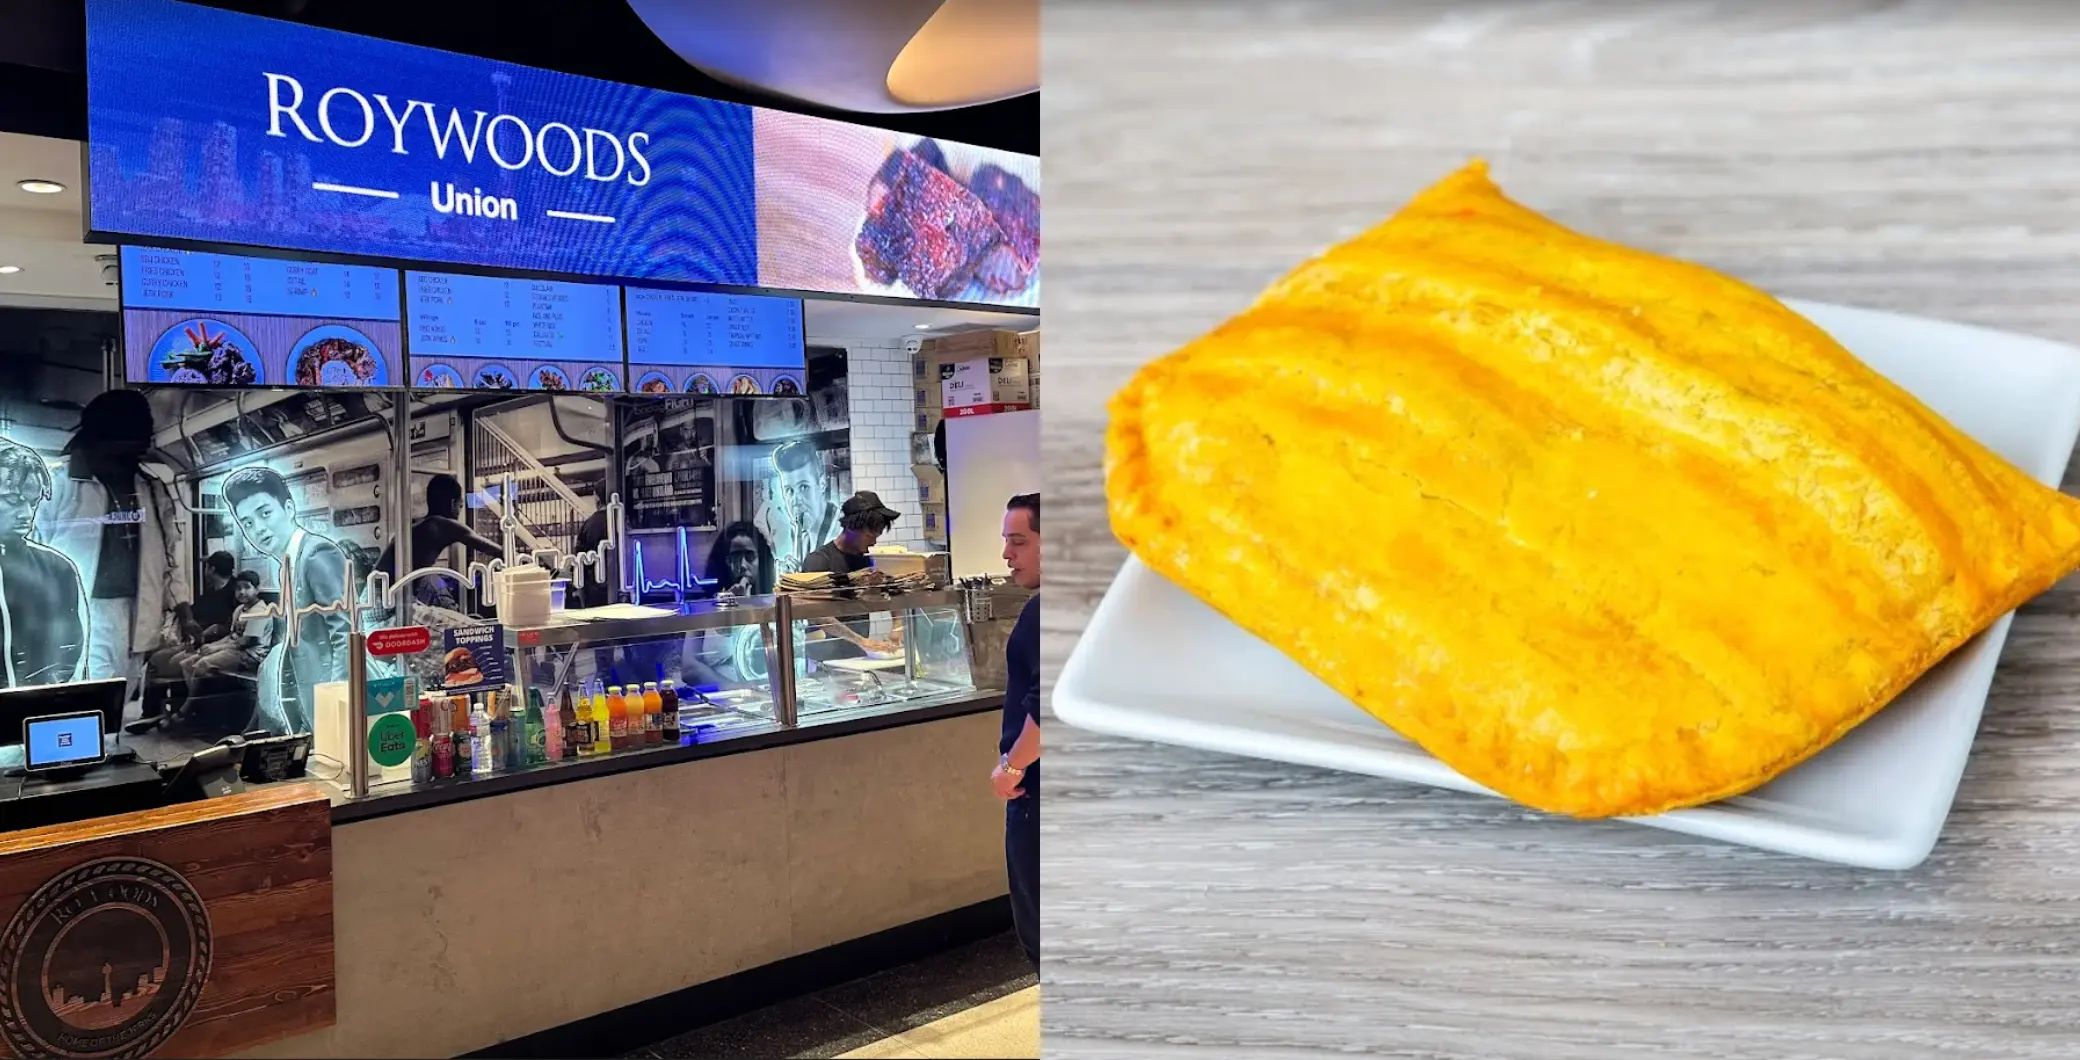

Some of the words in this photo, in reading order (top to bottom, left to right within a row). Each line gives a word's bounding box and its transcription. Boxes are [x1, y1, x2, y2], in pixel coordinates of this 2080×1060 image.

[262, 71, 652, 187] ROYWOODS
[431, 181, 518, 221] Union
[453, 625, 495, 637] SANDWICH
[384, 638, 427, 649] DOORDASH
[455, 634, 494, 645] TOPPINGS
[380, 731, 405, 742] Uber
[380, 741, 406, 753] Eats
